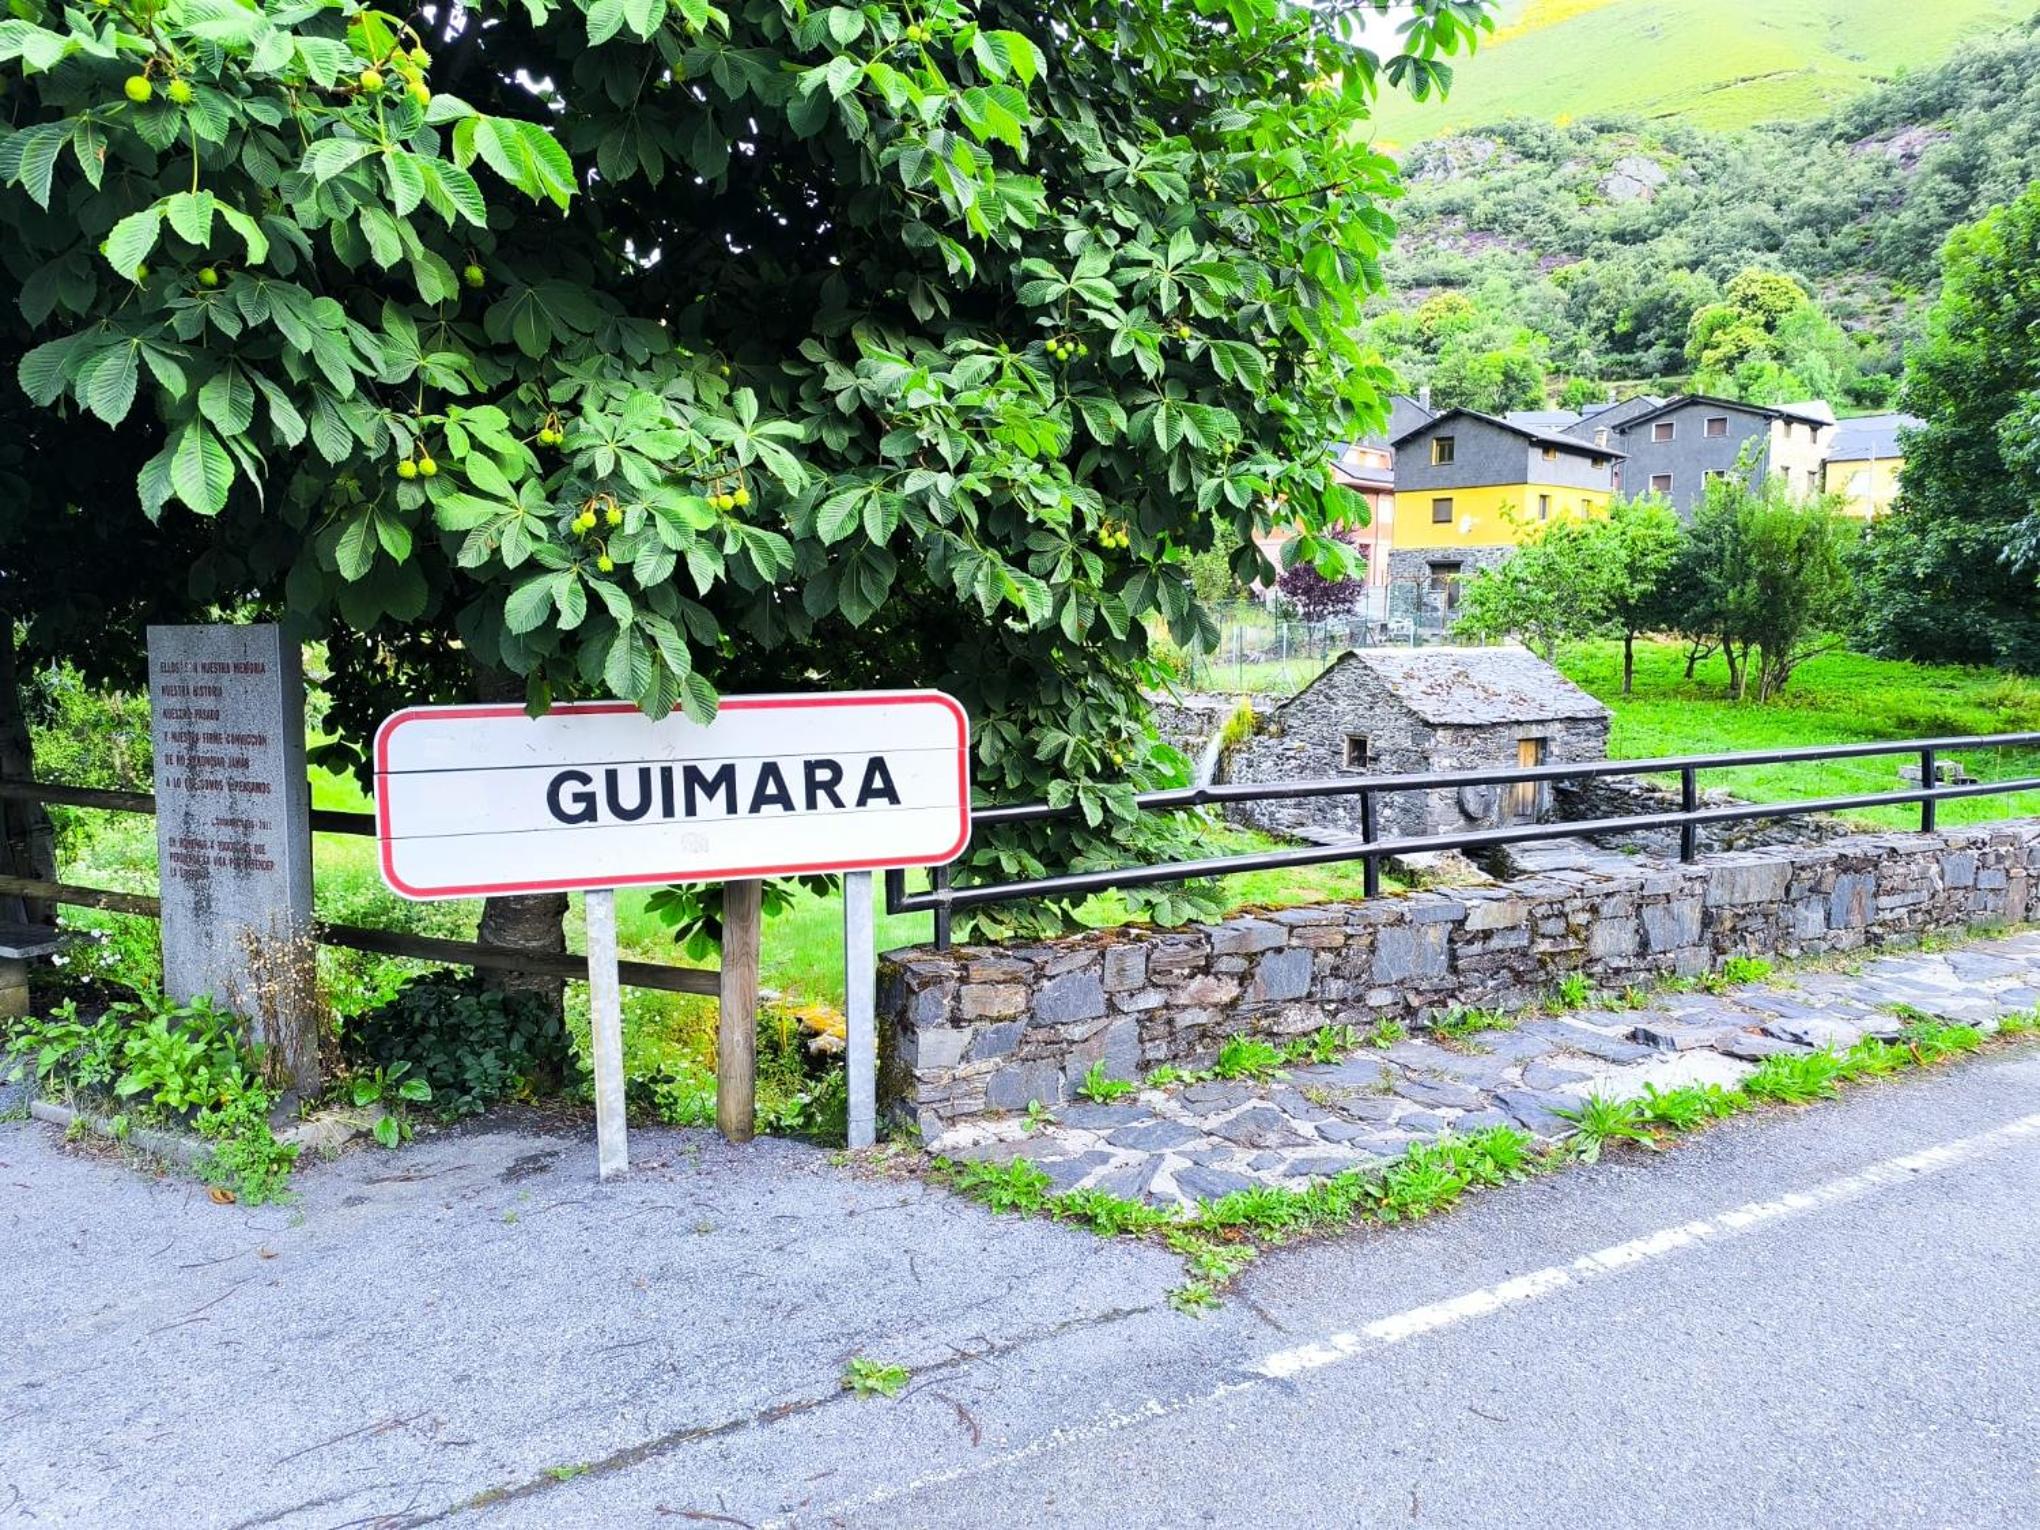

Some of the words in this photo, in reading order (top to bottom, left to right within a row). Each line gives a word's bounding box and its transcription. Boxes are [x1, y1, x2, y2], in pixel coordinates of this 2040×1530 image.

[201, 661, 230, 674] NUESTRA
[233, 661, 266, 674] MEMORIA
[161, 685, 190, 696] NUESTRA
[193, 685, 223, 696] HISTORIA
[163, 708, 192, 720] NUESTRO
[195, 709, 220, 721] PASADO
[202, 732, 223, 744] FIRME
[165, 754, 173, 765] DE
[176, 754, 185, 766] NO
[174, 777, 182, 788] LO
[546, 755, 901, 824] GUIMARA
